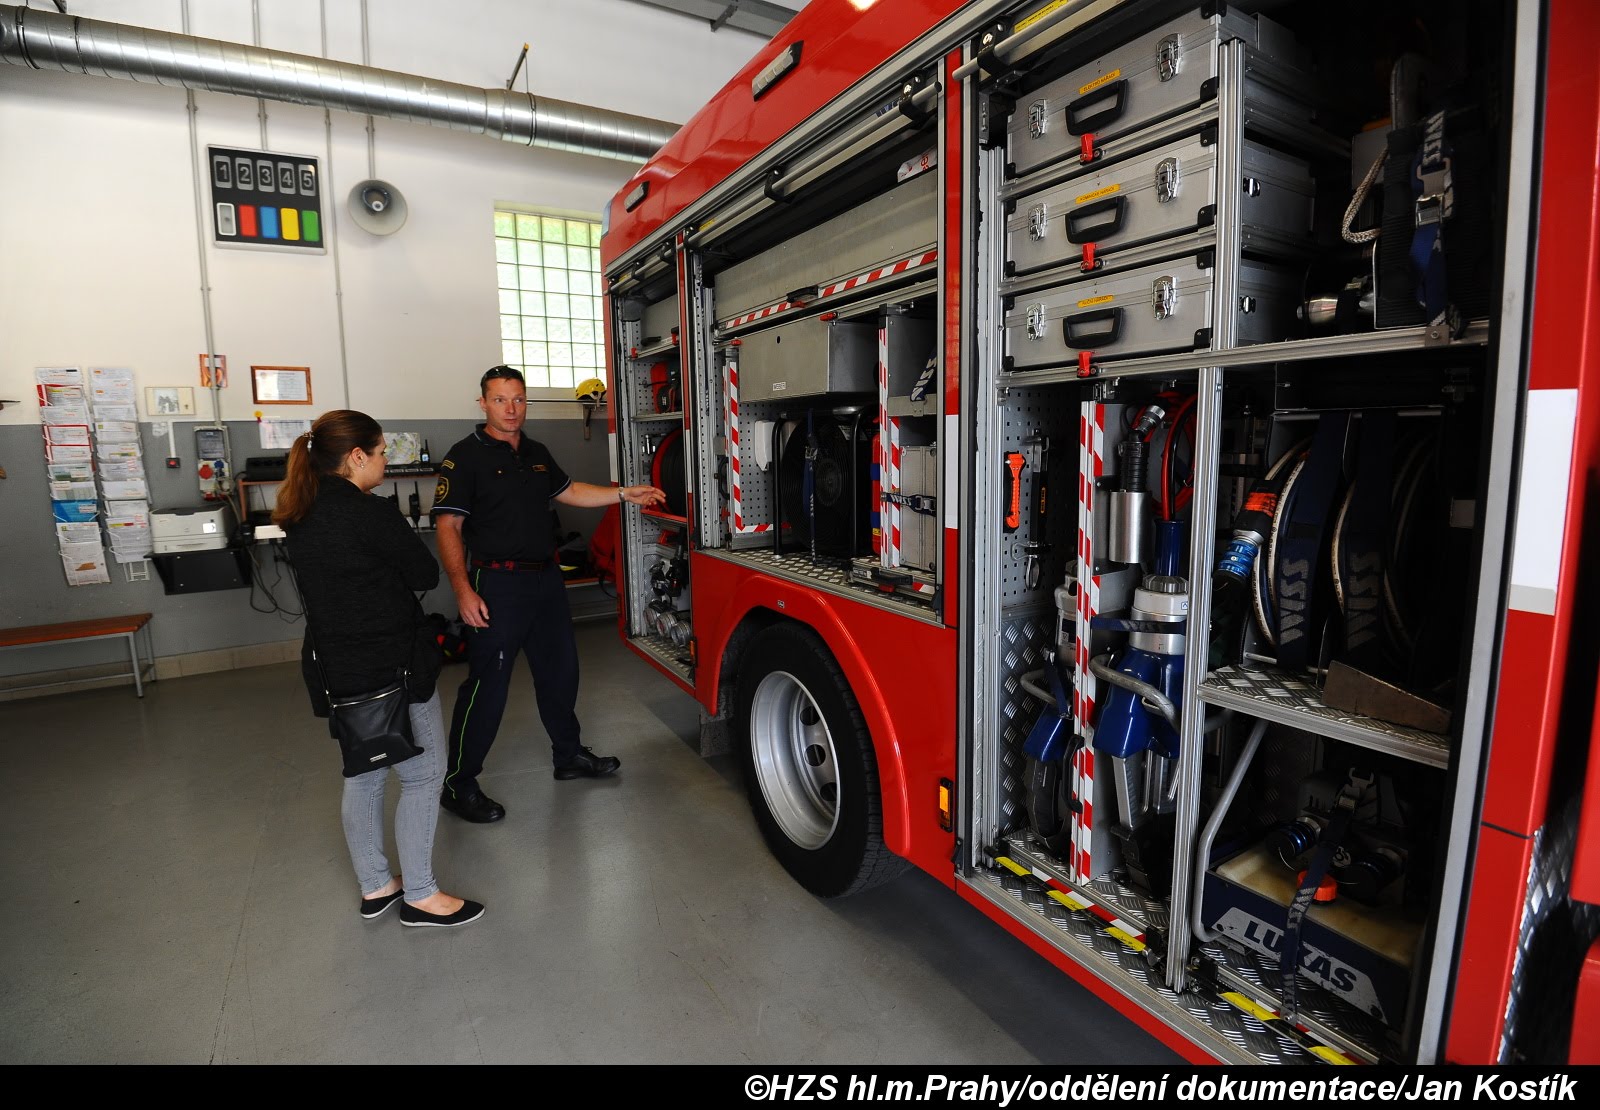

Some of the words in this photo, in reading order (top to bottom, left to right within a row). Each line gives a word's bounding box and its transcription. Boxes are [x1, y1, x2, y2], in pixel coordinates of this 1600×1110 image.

[220, 164, 228, 180] 1
[240, 166, 250, 182] 2
[261, 168, 271, 184] 3
[282, 171, 292, 186] 4
[303, 173, 313, 188] 5
[890, 494, 912, 506] WISS
[1280, 558, 1309, 646] WISS
